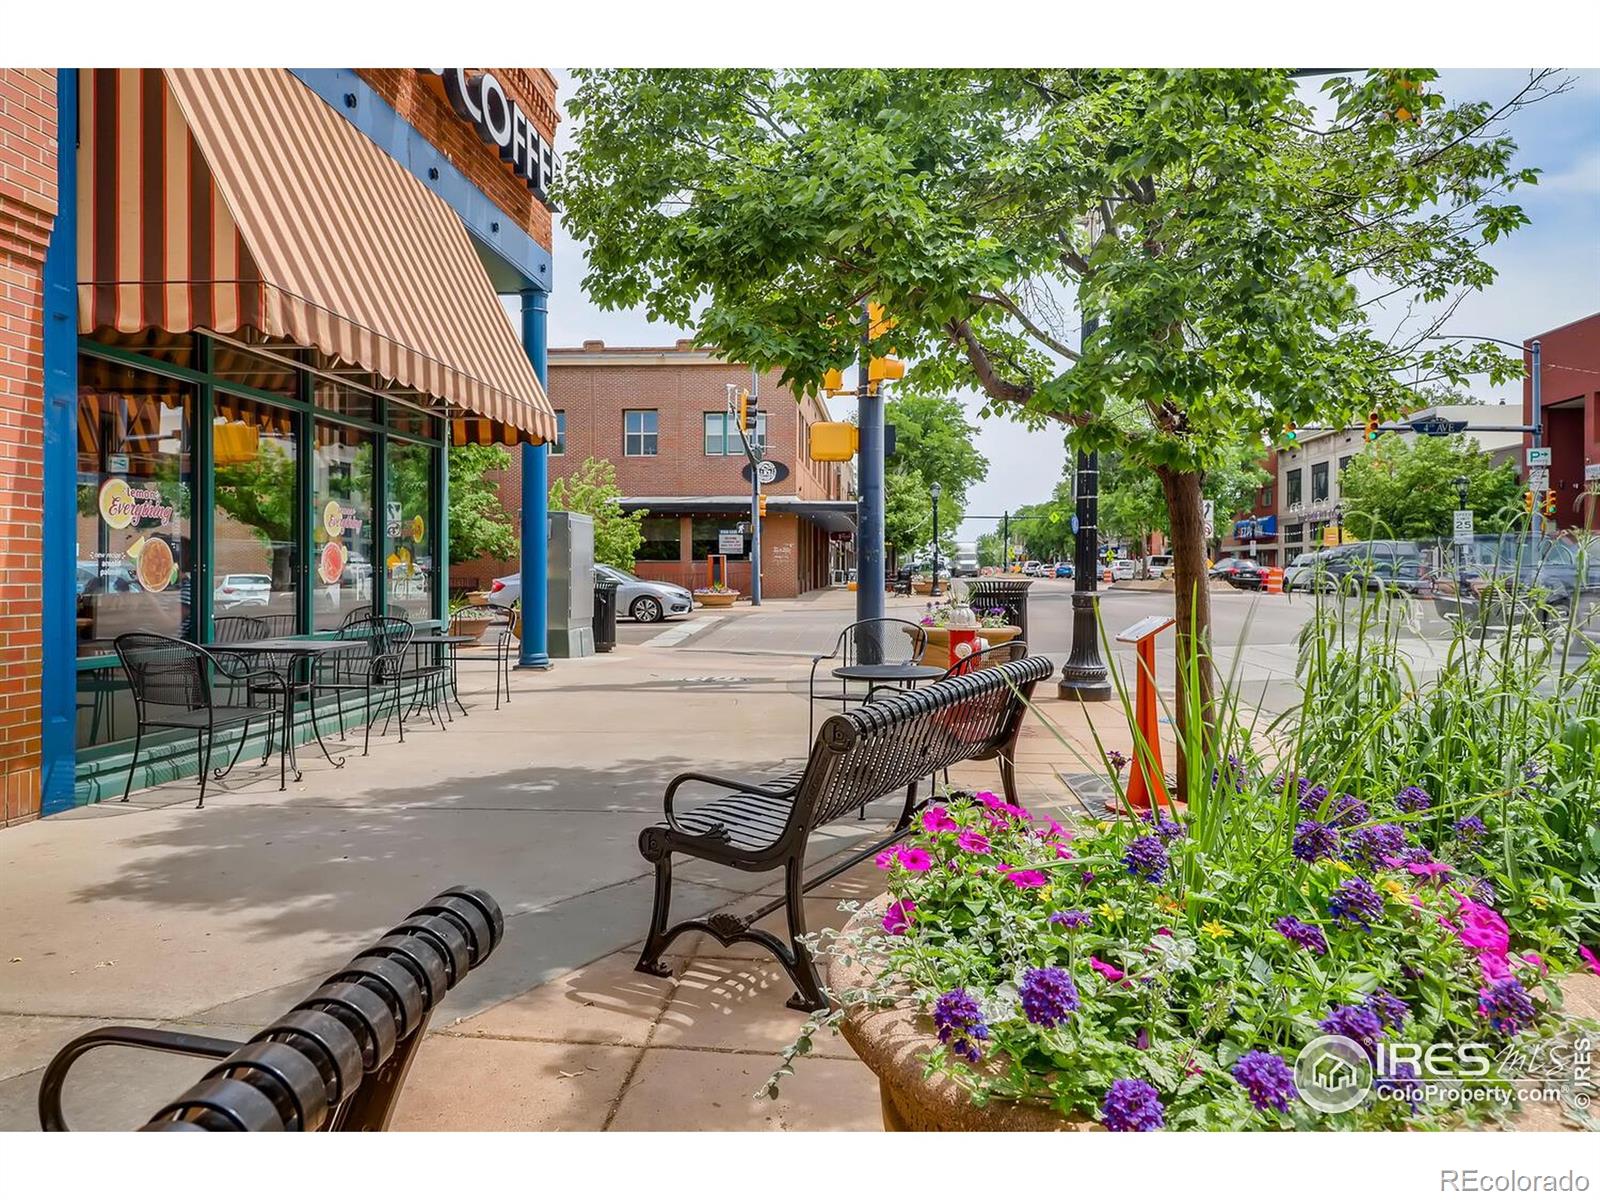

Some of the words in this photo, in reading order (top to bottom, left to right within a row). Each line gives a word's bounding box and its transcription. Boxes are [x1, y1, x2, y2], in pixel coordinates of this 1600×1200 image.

[1436, 422, 1455, 432] AVE
[1530, 451, 1540, 463] P
[109, 496, 173, 526] Everything
[1456, 521, 1471, 529] 25
